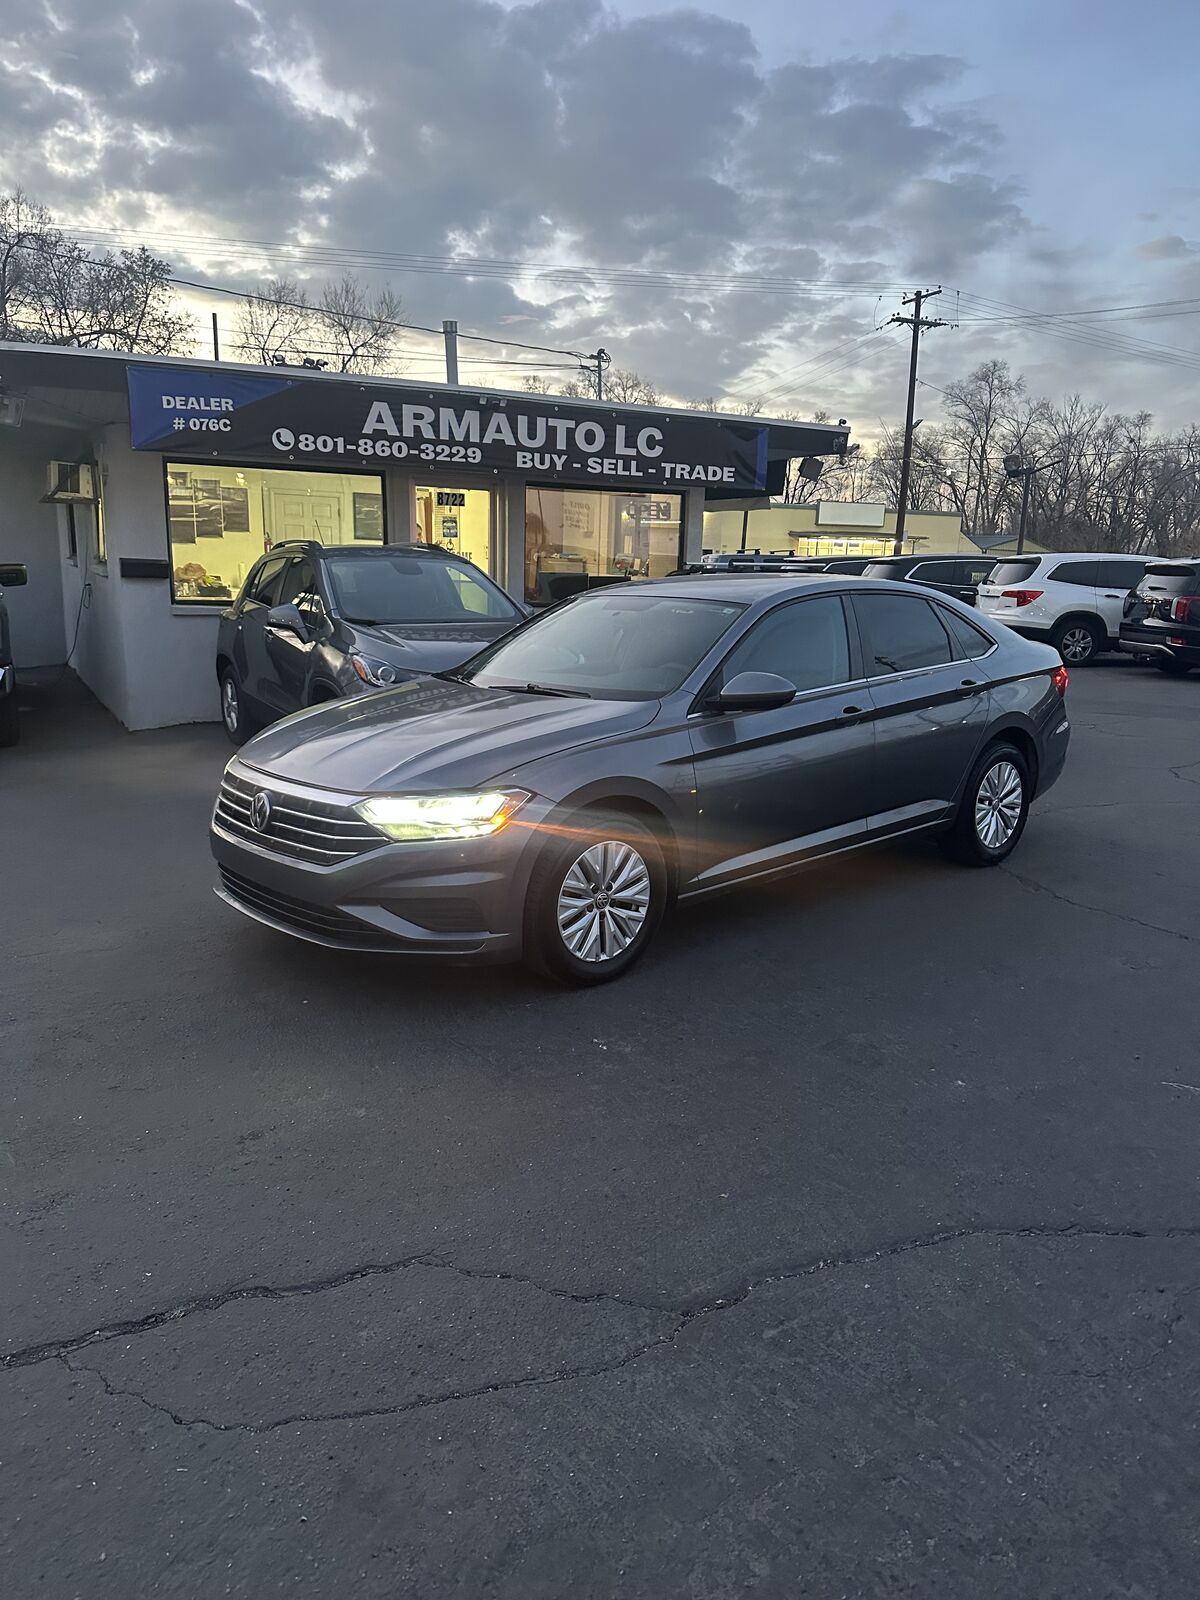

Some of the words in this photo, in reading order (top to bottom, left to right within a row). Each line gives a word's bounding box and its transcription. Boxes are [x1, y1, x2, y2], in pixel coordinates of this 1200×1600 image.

[162, 395, 234, 411] DEALER
[173, 417, 185, 430] #
[189, 418, 231, 432] 076C
[361, 400, 605, 453] ARMAUTO
[615, 424, 664, 457] LC
[298, 433, 482, 463] 801-860-3229
[516, 451, 567, 471] BUY
[587, 457, 643, 477] SELL
[661, 462, 736, 482] TRADE
[437, 492, 465, 506] 8722
